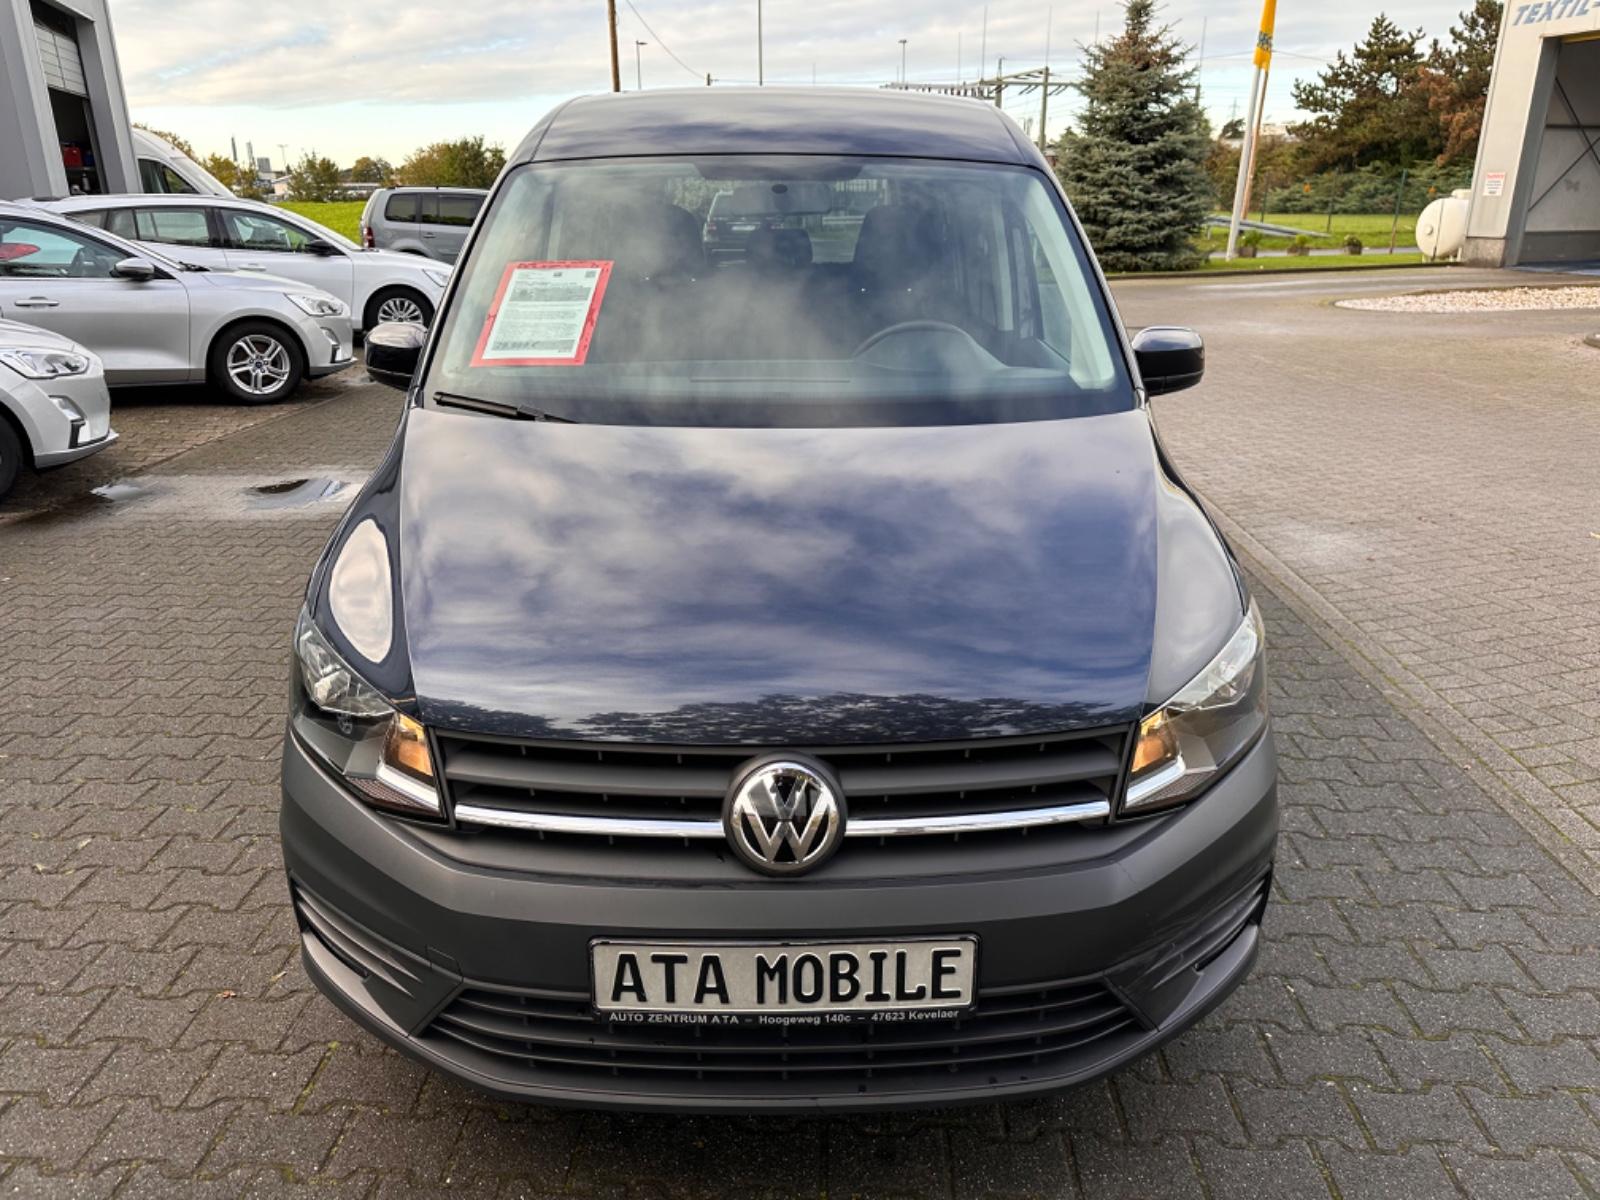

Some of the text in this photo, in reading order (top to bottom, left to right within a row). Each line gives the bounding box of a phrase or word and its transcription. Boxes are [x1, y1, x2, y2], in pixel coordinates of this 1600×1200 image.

[733, 763, 837, 869] VW
[611, 948, 962, 1004] ATA MOBILE
[608, 1011, 644, 1022] AUTO
[648, 1013, 708, 1024] ZENTRUM
[759, 1015, 821, 1026] Hoogeweg
[825, 1013, 852, 1023] 140c
[872, 1012, 905, 1022] 47623
[909, 1009, 960, 1020] Kevelaer
